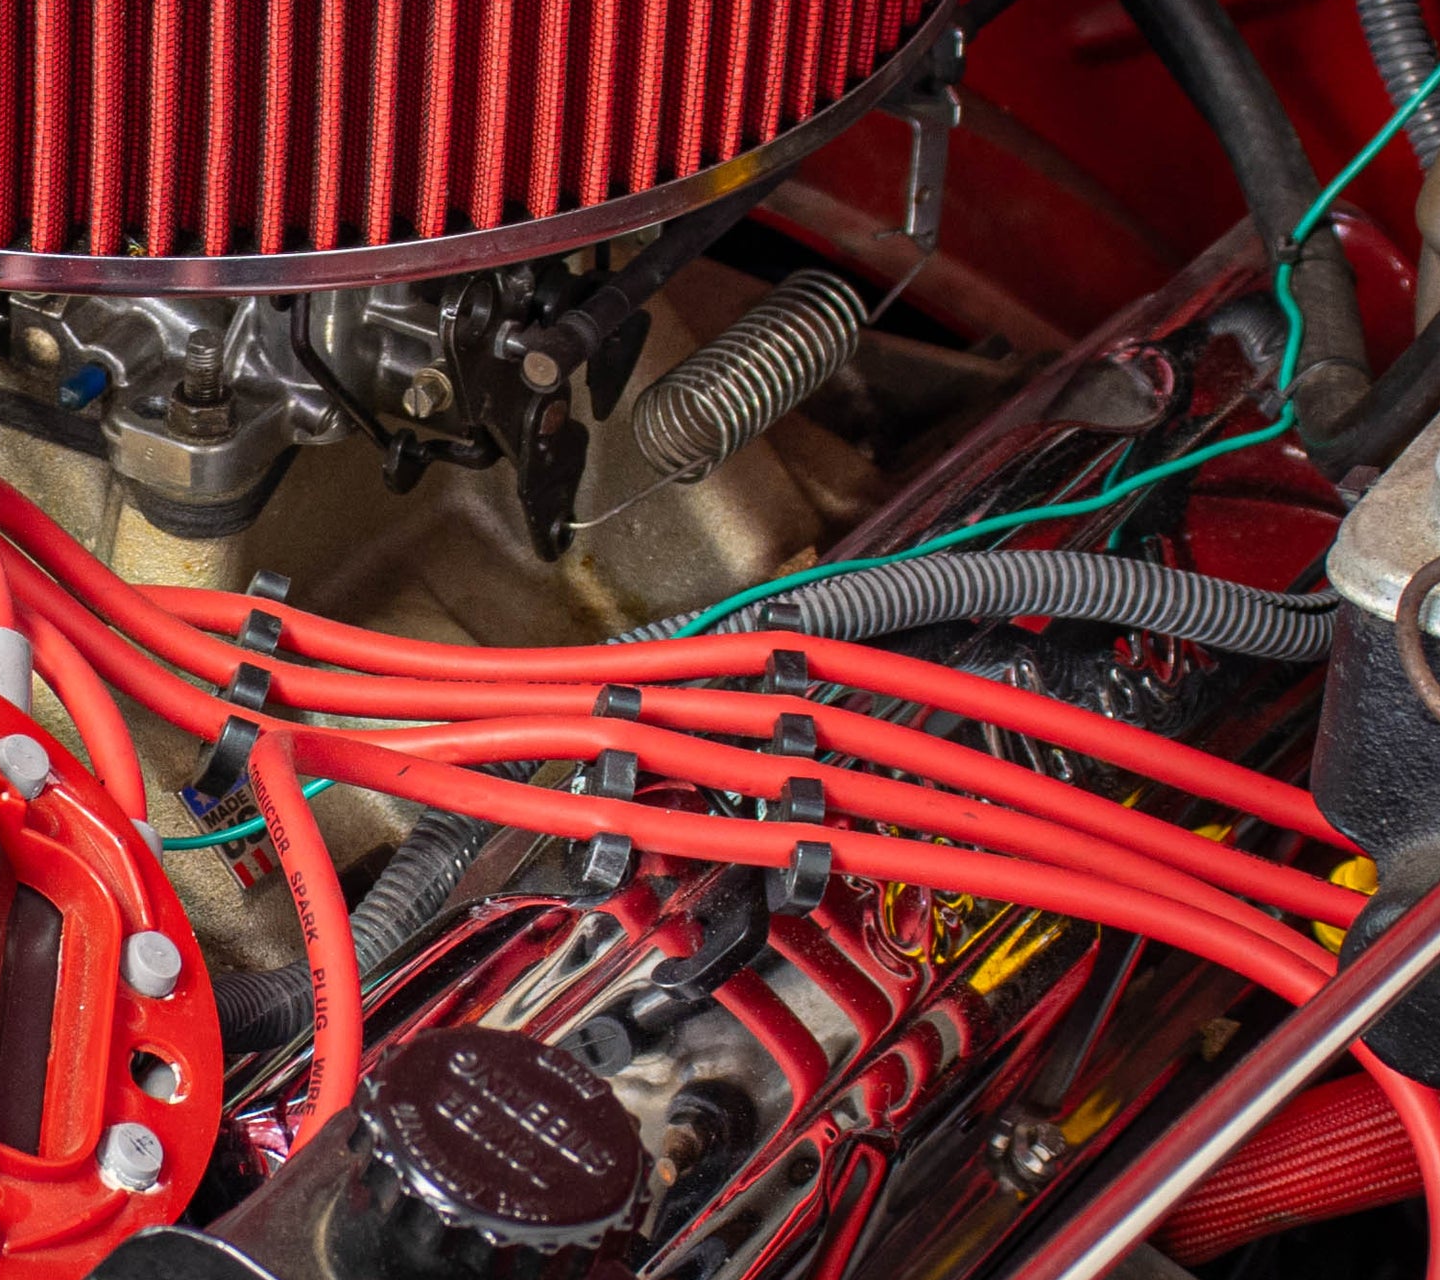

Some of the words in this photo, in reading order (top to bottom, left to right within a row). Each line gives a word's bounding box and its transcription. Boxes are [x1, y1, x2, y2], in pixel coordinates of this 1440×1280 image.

[200, 789, 251, 830] MADE
[249, 763, 291, 857] CONDUCTOR
[290, 870, 319, 944] SPARK
[313, 967, 329, 1032] PLUG
[305, 1056, 328, 1116] WIRE
